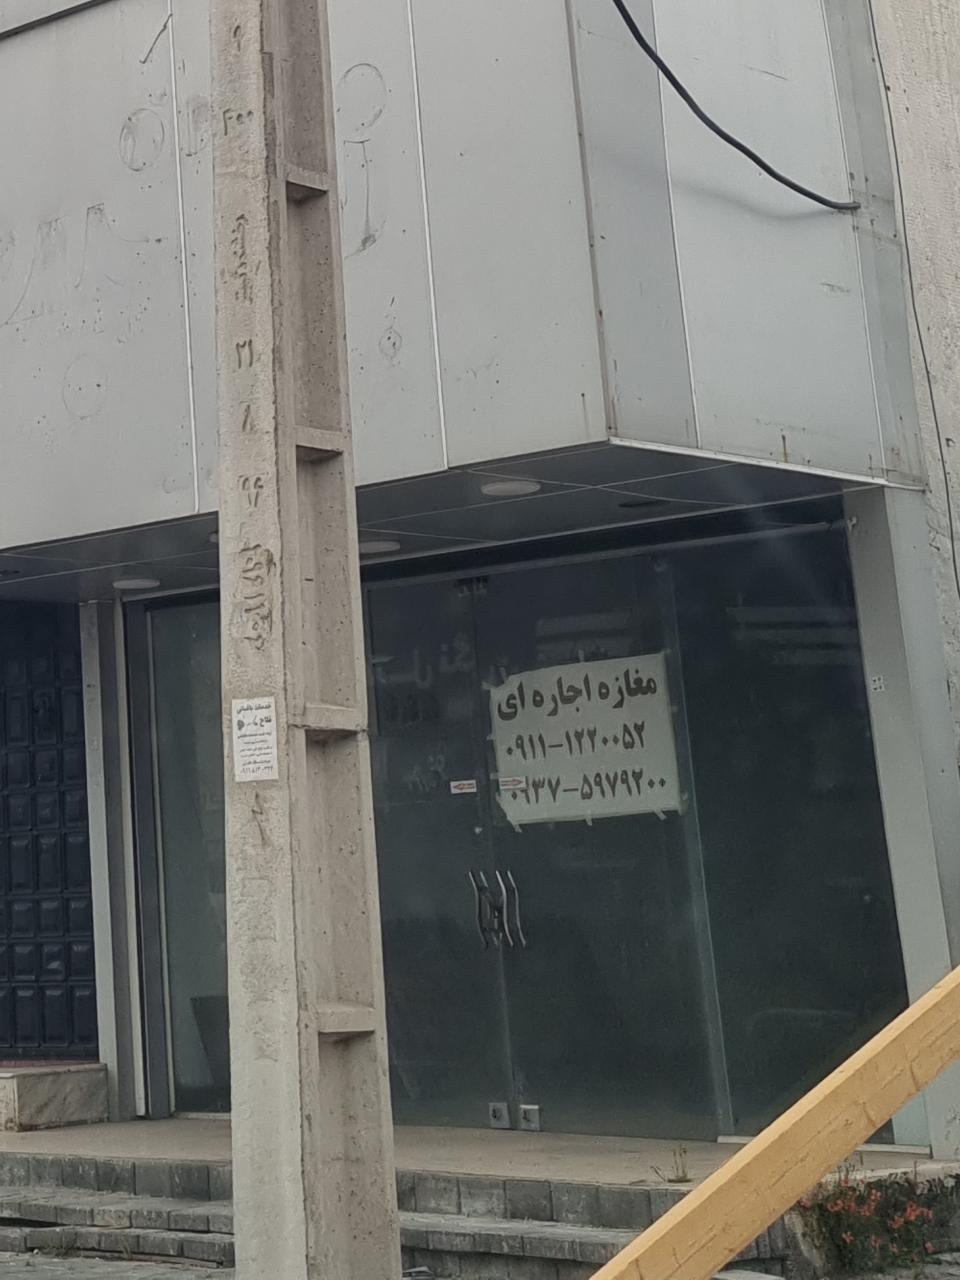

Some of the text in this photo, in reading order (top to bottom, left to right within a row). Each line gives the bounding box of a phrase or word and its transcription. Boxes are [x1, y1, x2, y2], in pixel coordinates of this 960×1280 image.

[497, 668, 658, 721] مغازه اجاره ای
